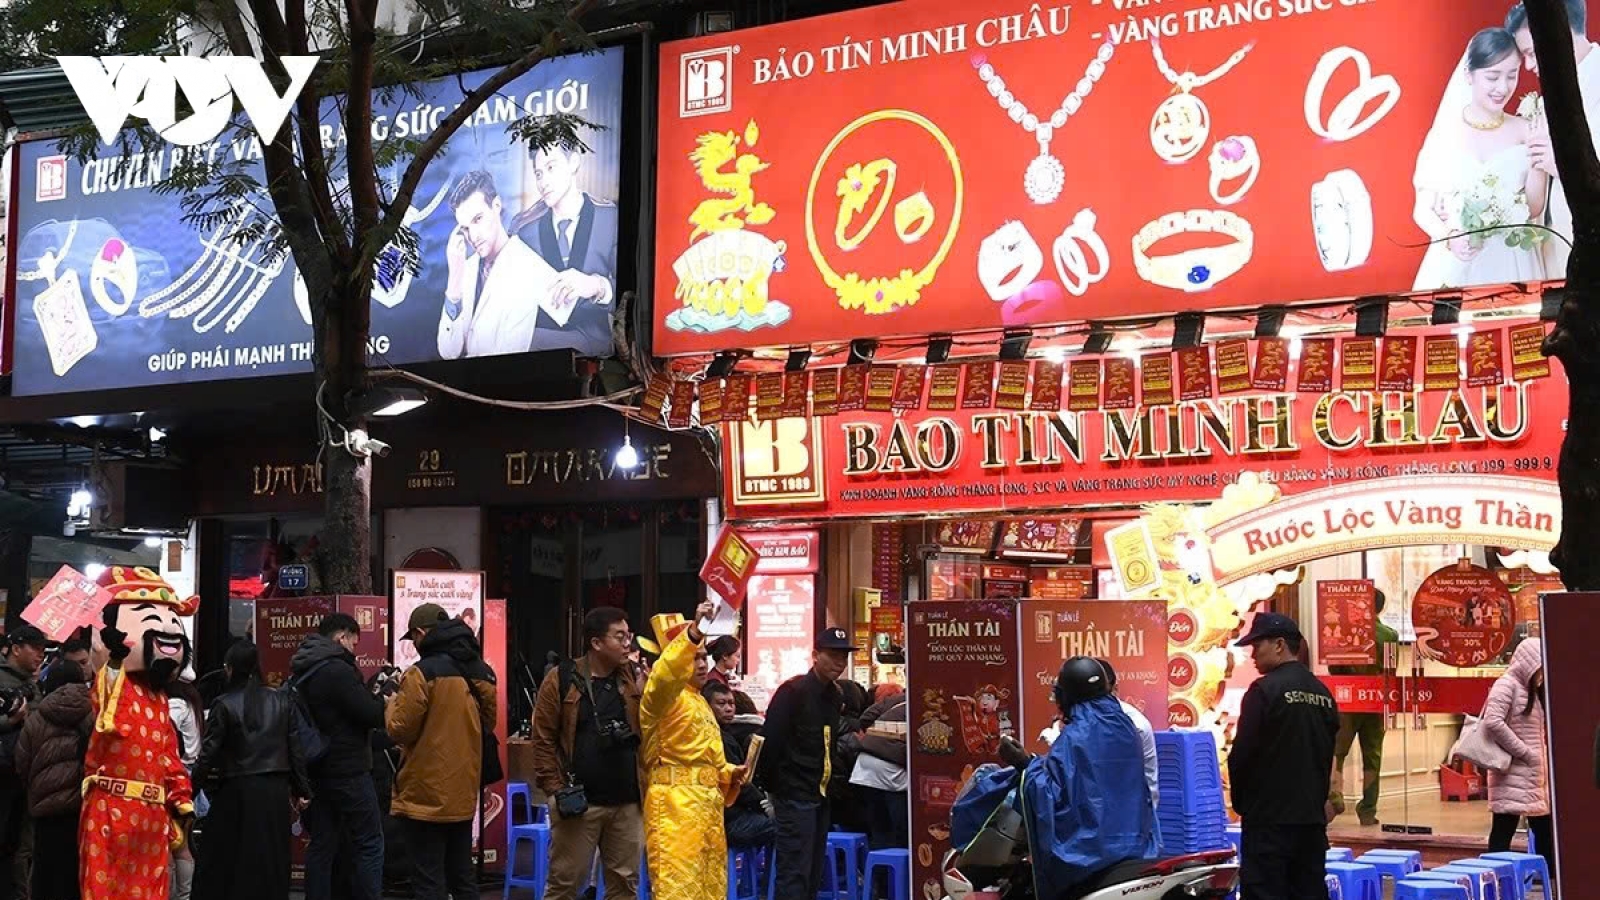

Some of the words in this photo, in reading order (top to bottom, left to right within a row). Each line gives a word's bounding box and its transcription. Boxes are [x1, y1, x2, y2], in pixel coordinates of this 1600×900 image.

[1108, 14, 1179, 45] VÀNG
[1184, 0, 1272, 33] TRANG
[753, 47, 814, 85] BẢO
[821, 36, 872, 73] TÍN
[880, 24, 967, 65] MINH
[975, 3, 1072, 49] CHÂU
[524, 79, 589, 116] GIỚI
[148, 348, 186, 372] GIÚP
[192, 345, 229, 370] PHÁI
[235, 344, 286, 369] MẠNH
[842, 407, 965, 475] BẢO
[1100, 394, 1298, 461] MINH
[420, 450, 440, 470] 29
[744, 478, 778, 493] BTMC
[781, 476, 811, 491] 1989
[864, 488, 897, 500] DOANH
[901, 485, 928, 498] VÀNG
[930, 482, 959, 498] RỒNG
[1055, 478, 1068, 492] VÀ
[1072, 476, 1100, 491] VÀNG
[1103, 477, 1140, 490] TRANG
[1143, 473, 1162, 489] SỨC
[1167, 472, 1184, 488] MỸ
[1187, 472, 1218, 489] NGHỆ
[1514, 456, 1552, 470] 999.9
[1243, 519, 1314, 555] Rước
[1324, 504, 1376, 535] Lộc
[1384, 500, 1463, 529] Vàng
[1475, 499, 1554, 533] Thần
[288, 578, 300, 586] 17
[407, 588, 427, 600] Trang
[974, 618, 1000, 637] TÀI
[1168, 621, 1191, 633] Đón
[1057, 621, 1111, 660] THẦN
[1115, 623, 1145, 657] TÀI
[1464, 638, 1481, 647] 30%
[978, 653, 1005, 661] KHANG
[1170, 665, 1188, 679] Lộc
[1284, 690, 1333, 709] SECURITY
[1405, 690, 1432, 701] 189
